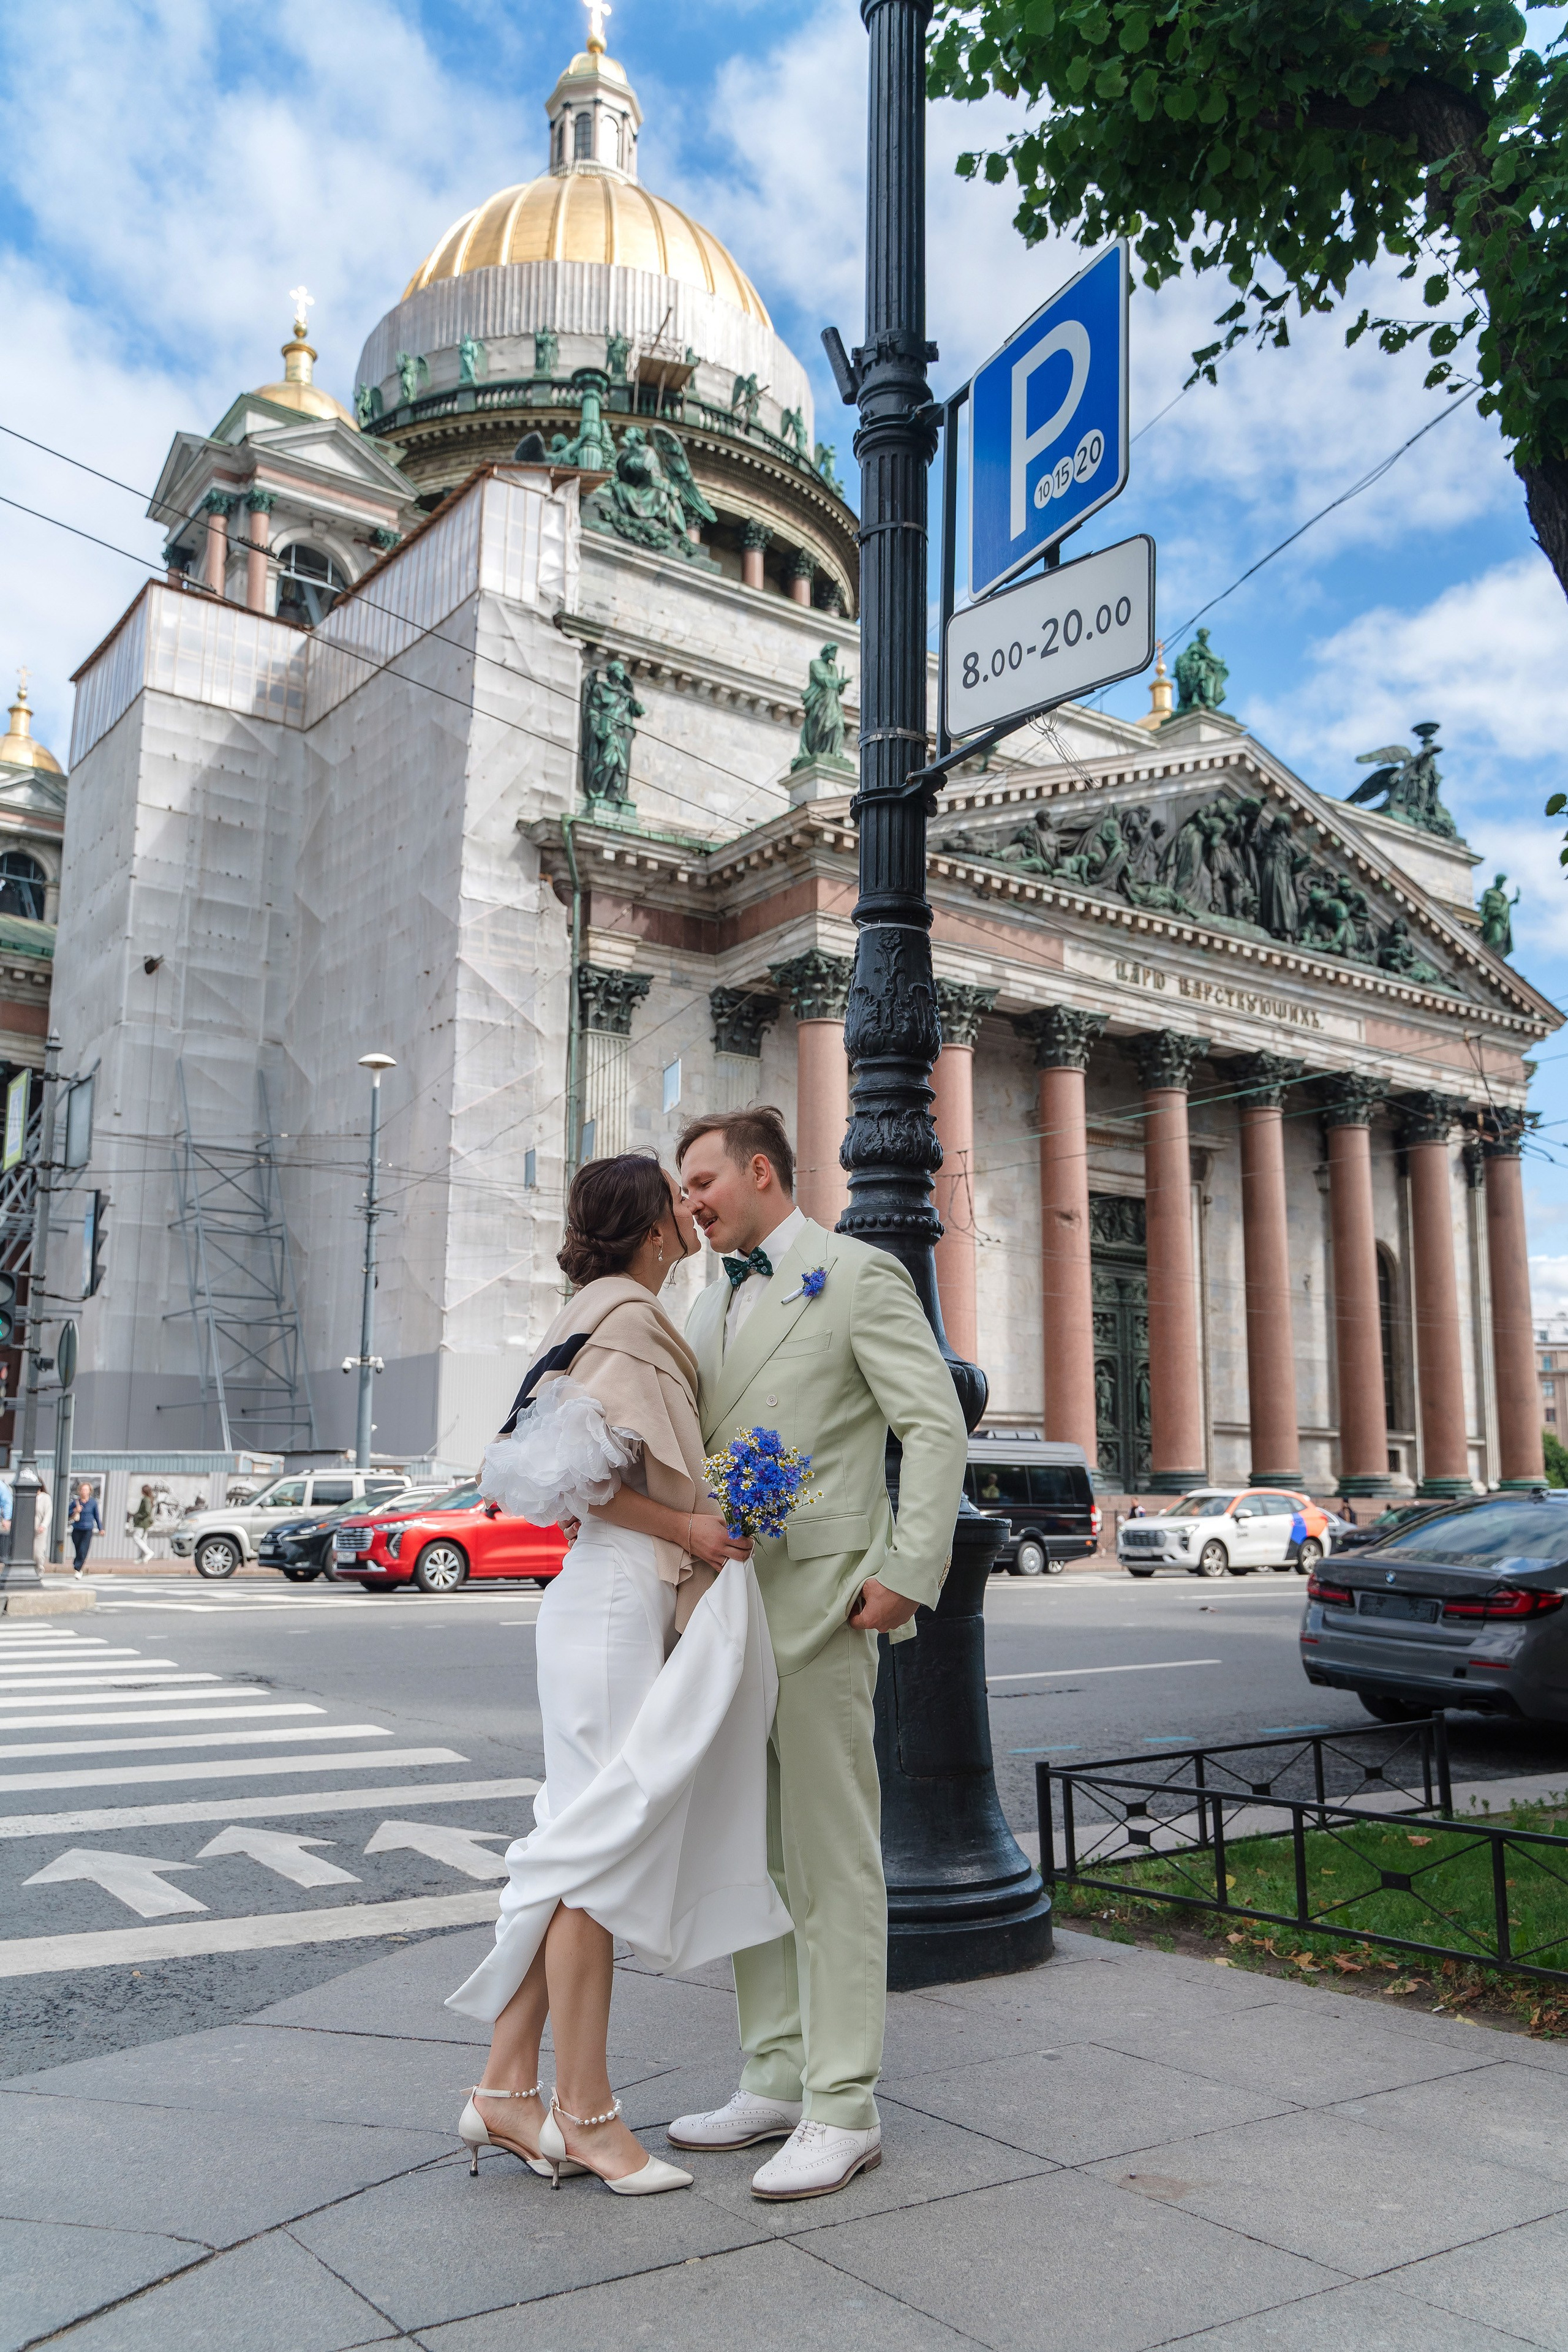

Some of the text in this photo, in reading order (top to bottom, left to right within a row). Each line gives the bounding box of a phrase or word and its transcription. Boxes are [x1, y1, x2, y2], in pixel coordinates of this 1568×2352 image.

[1009, 319, 1091, 541] P
[1038, 435, 1101, 502] 10 15 20
[962, 596, 1131, 689] 8.00-20.00
[1116, 960, 1165, 990] ЦАРЮ
